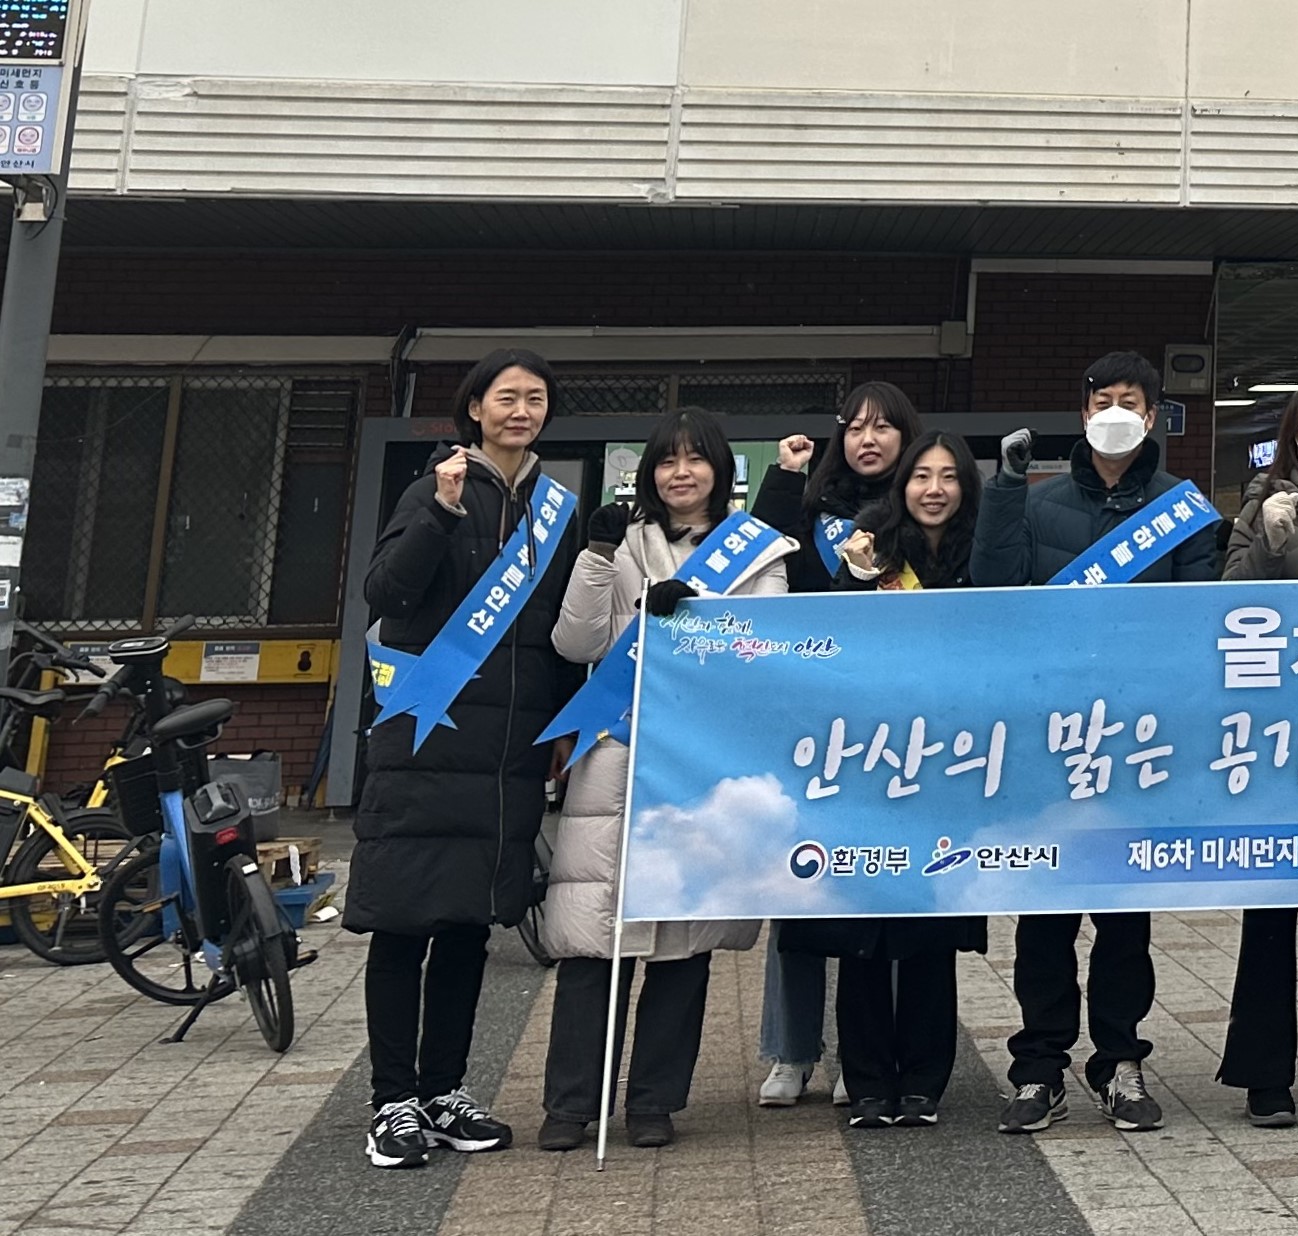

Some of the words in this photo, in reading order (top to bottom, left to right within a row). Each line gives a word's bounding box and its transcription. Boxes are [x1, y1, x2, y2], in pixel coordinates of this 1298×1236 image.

[1110, 500, 1194, 567] 푸른하늘
[793, 716, 1007, 800] 안산의
[1048, 699, 1174, 800] 맑은
[831, 846, 909, 876] 환경부
[977, 845, 1059, 869] 안산시
[1128, 838, 1194, 872] 제6차
[1202, 834, 1298, 870] 미세먼지
